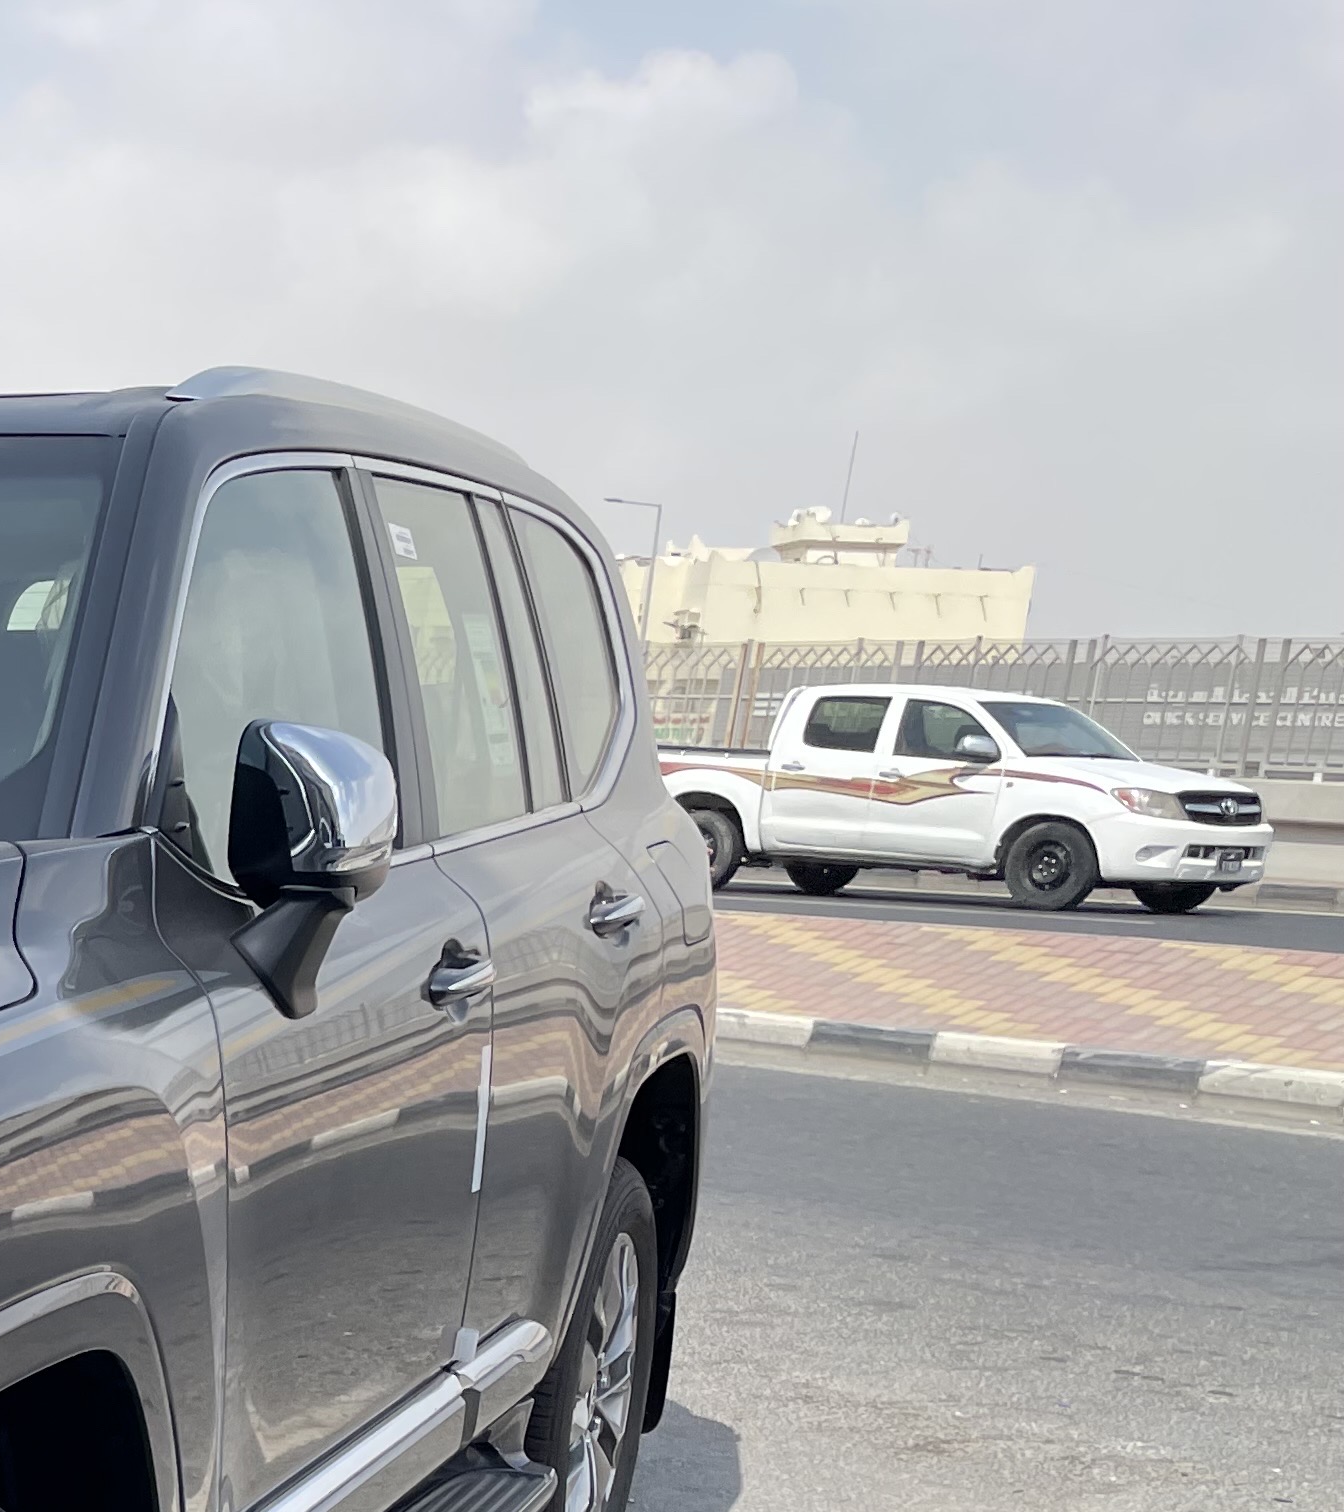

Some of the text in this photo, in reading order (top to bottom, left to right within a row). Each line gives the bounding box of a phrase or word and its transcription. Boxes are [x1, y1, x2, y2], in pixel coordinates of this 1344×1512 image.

[1143, 711, 1344, 727] QUICK SEVICE CENTRE
